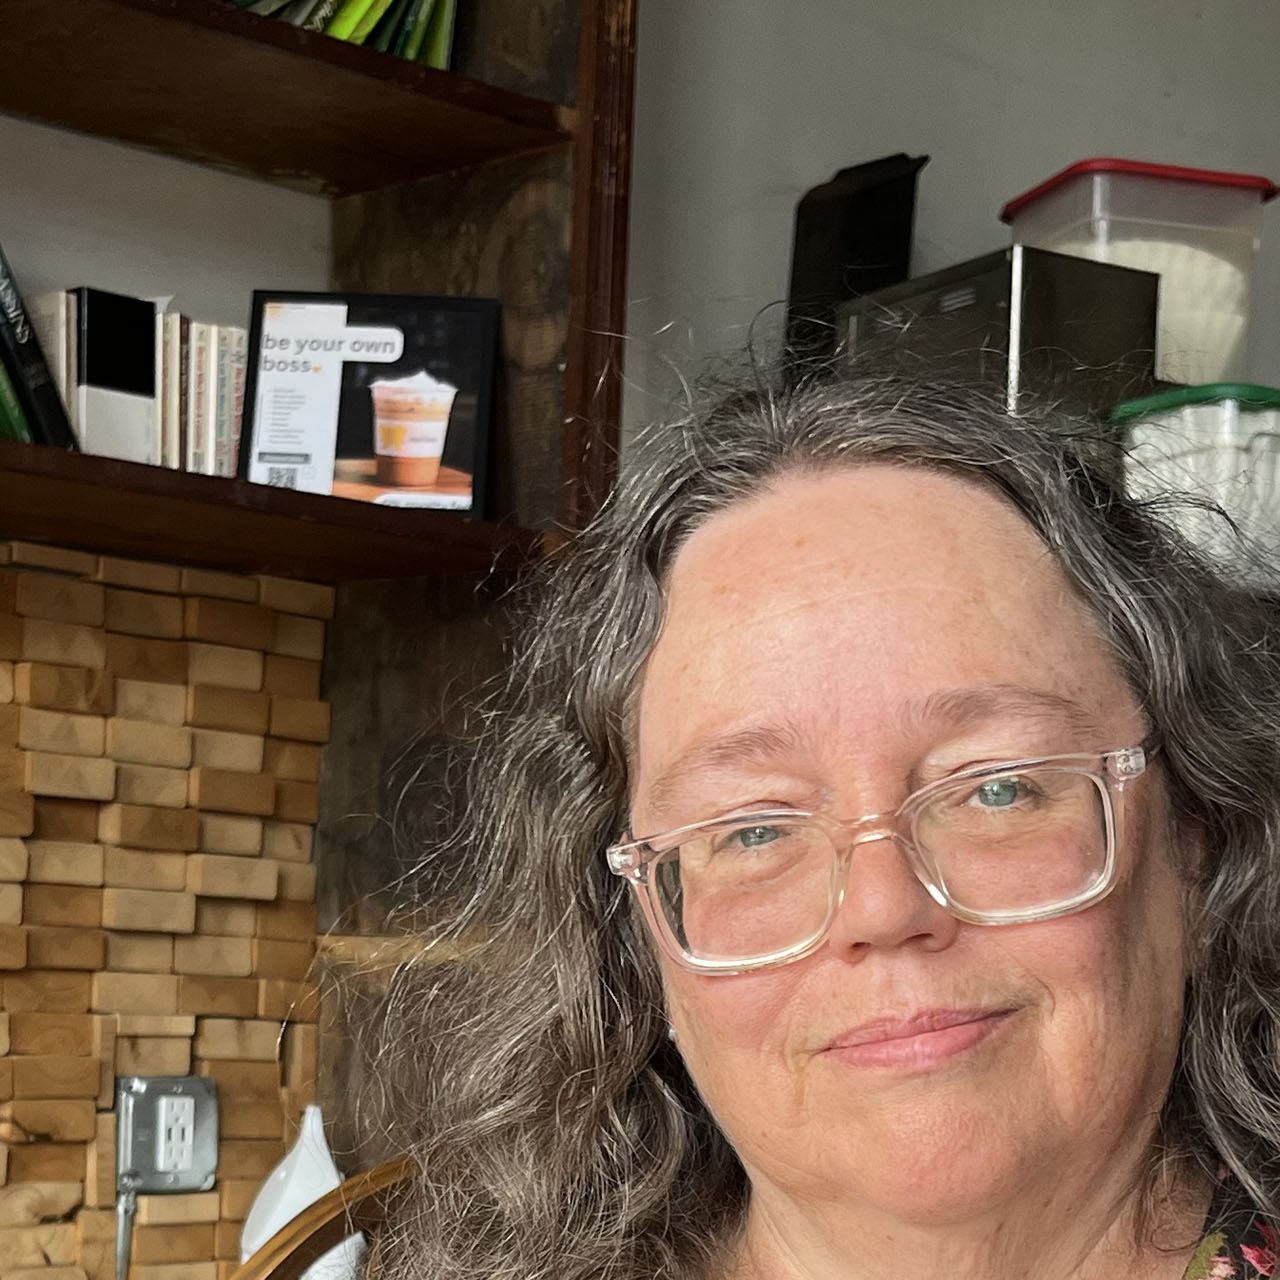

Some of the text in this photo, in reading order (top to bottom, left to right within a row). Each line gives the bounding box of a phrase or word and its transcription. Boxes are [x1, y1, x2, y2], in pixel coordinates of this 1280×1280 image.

[263, 334, 396, 355] be your own
